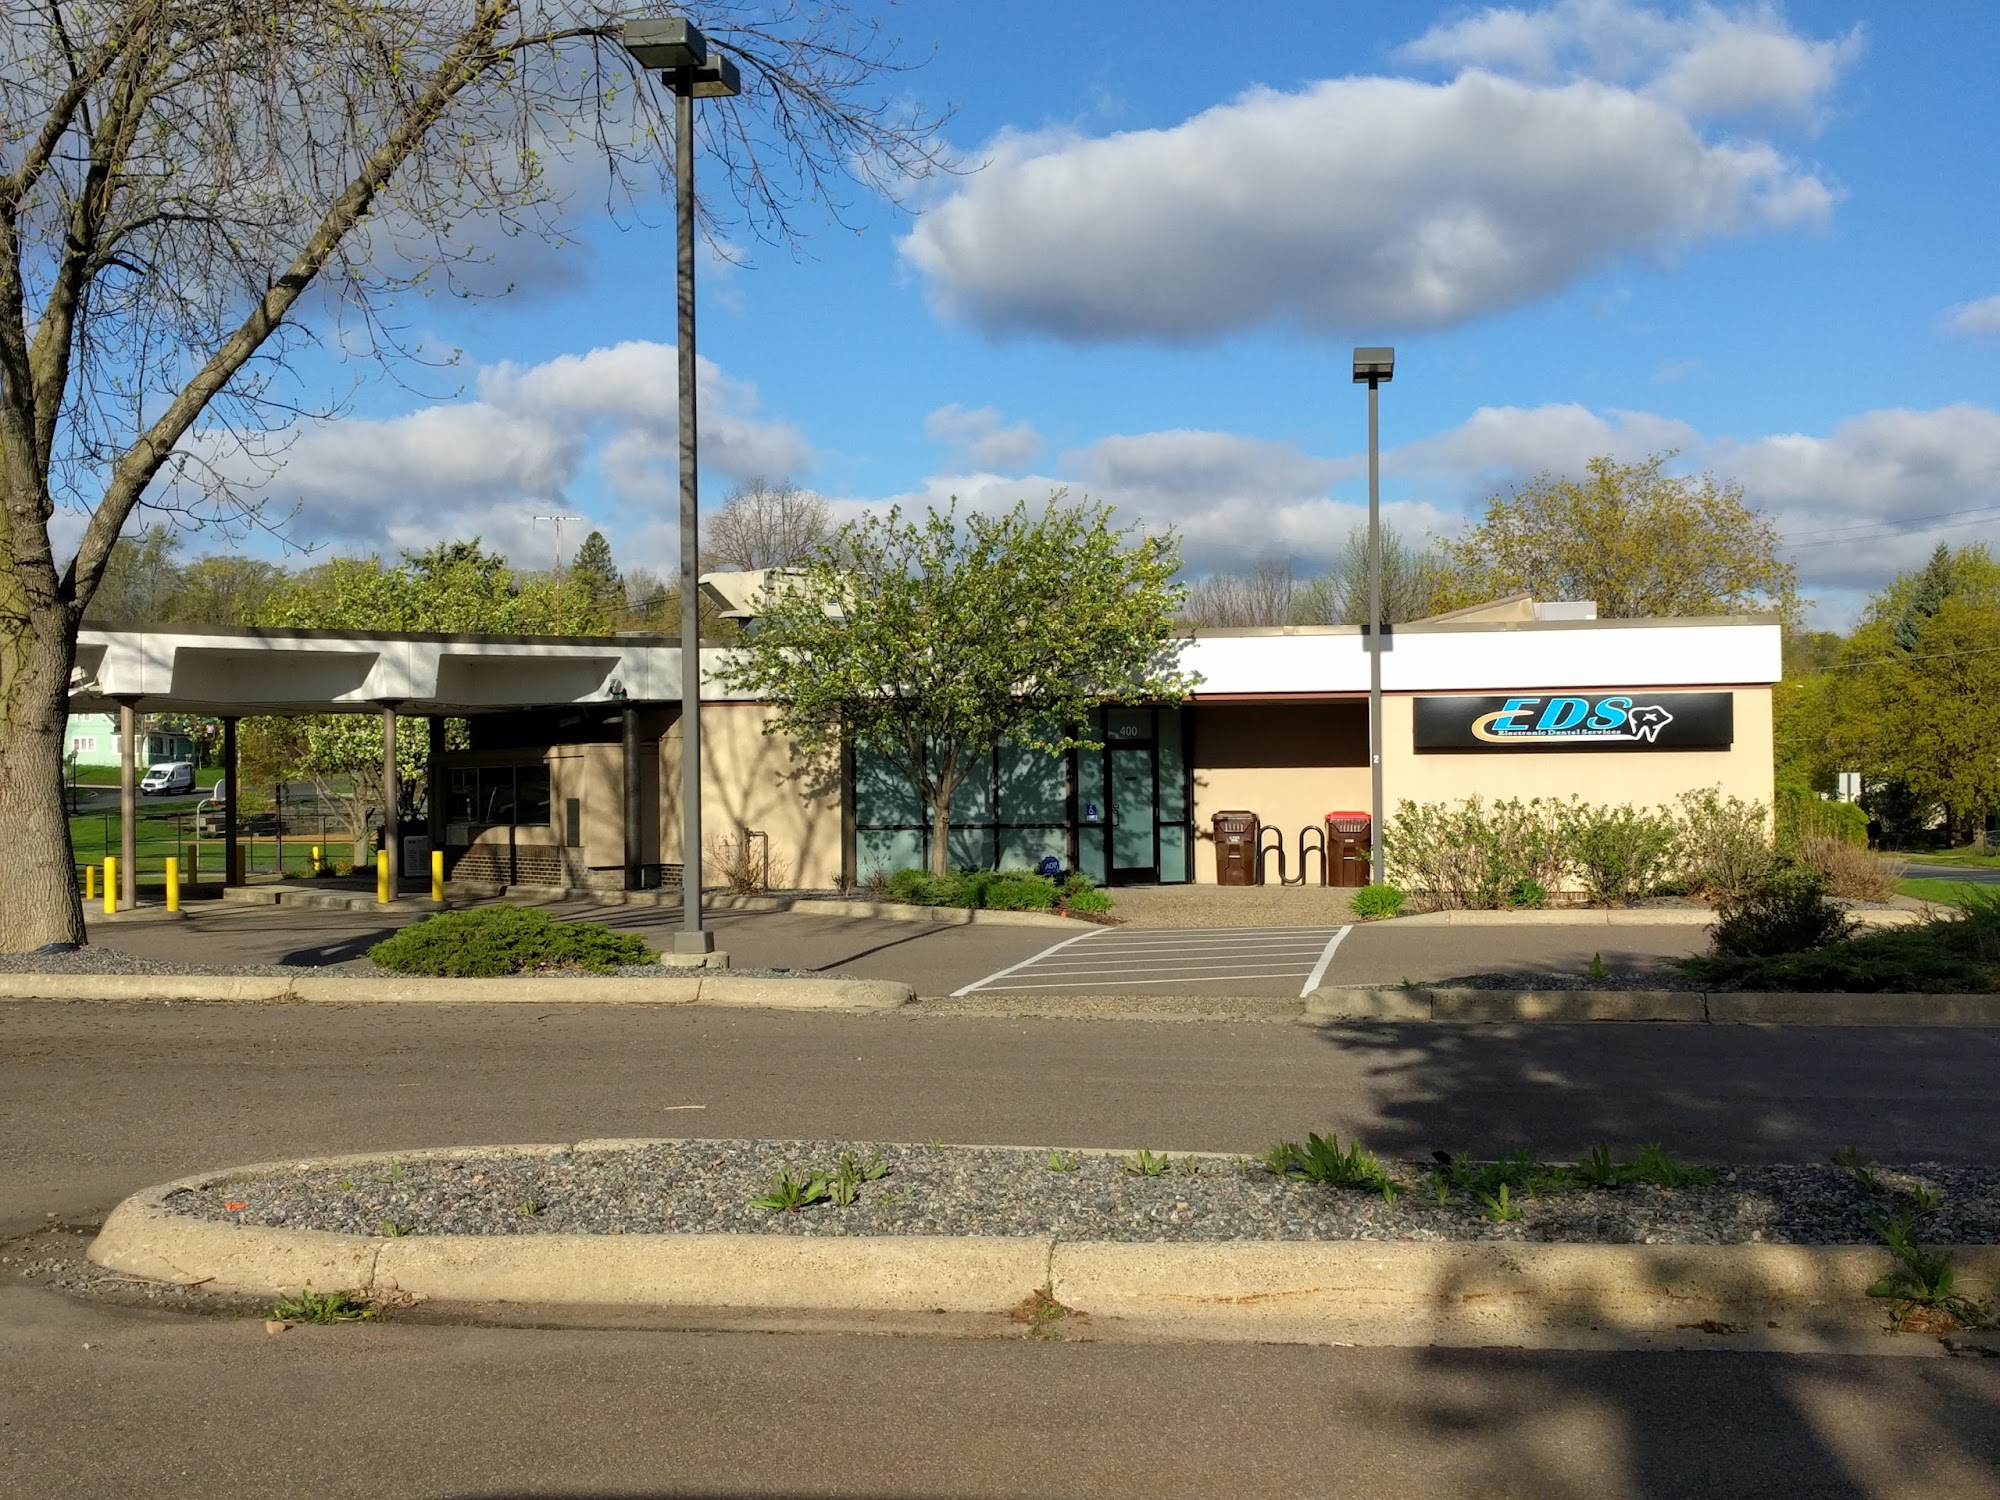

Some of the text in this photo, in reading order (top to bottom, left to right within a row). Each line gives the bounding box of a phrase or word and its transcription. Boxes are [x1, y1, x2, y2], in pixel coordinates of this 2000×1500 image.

[1492, 697, 1632, 730] EDS
[1120, 726, 1138, 736] 400
[1373, 754, 1379, 763] 2
